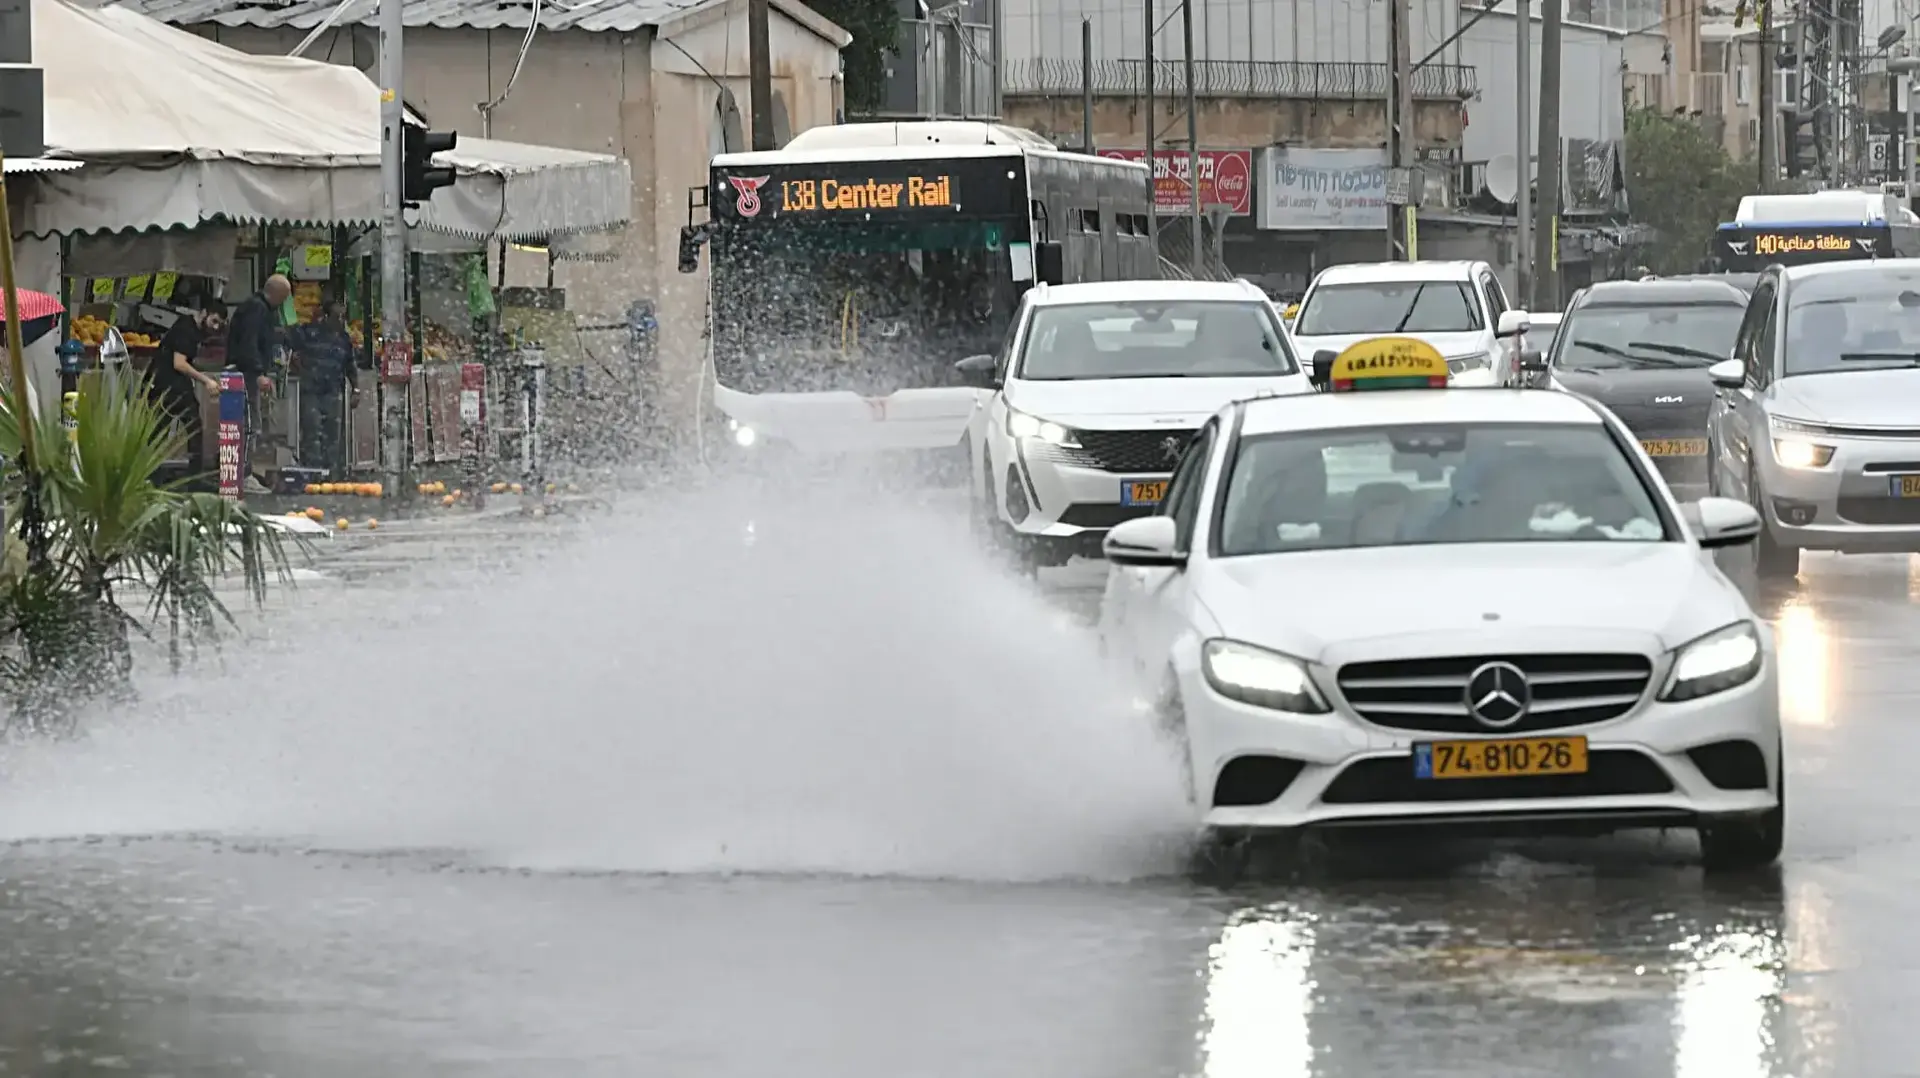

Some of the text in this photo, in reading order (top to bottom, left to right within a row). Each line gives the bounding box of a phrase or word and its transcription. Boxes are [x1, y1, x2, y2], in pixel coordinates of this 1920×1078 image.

[1173, 154, 1214, 179] פלפל
[781, 175, 950, 211] 138 Center Rail
[1755, 234, 1777, 255] 140
[1778, 234, 1851, 253] منطقة صناعية
[1135, 484, 1161, 500] 751
